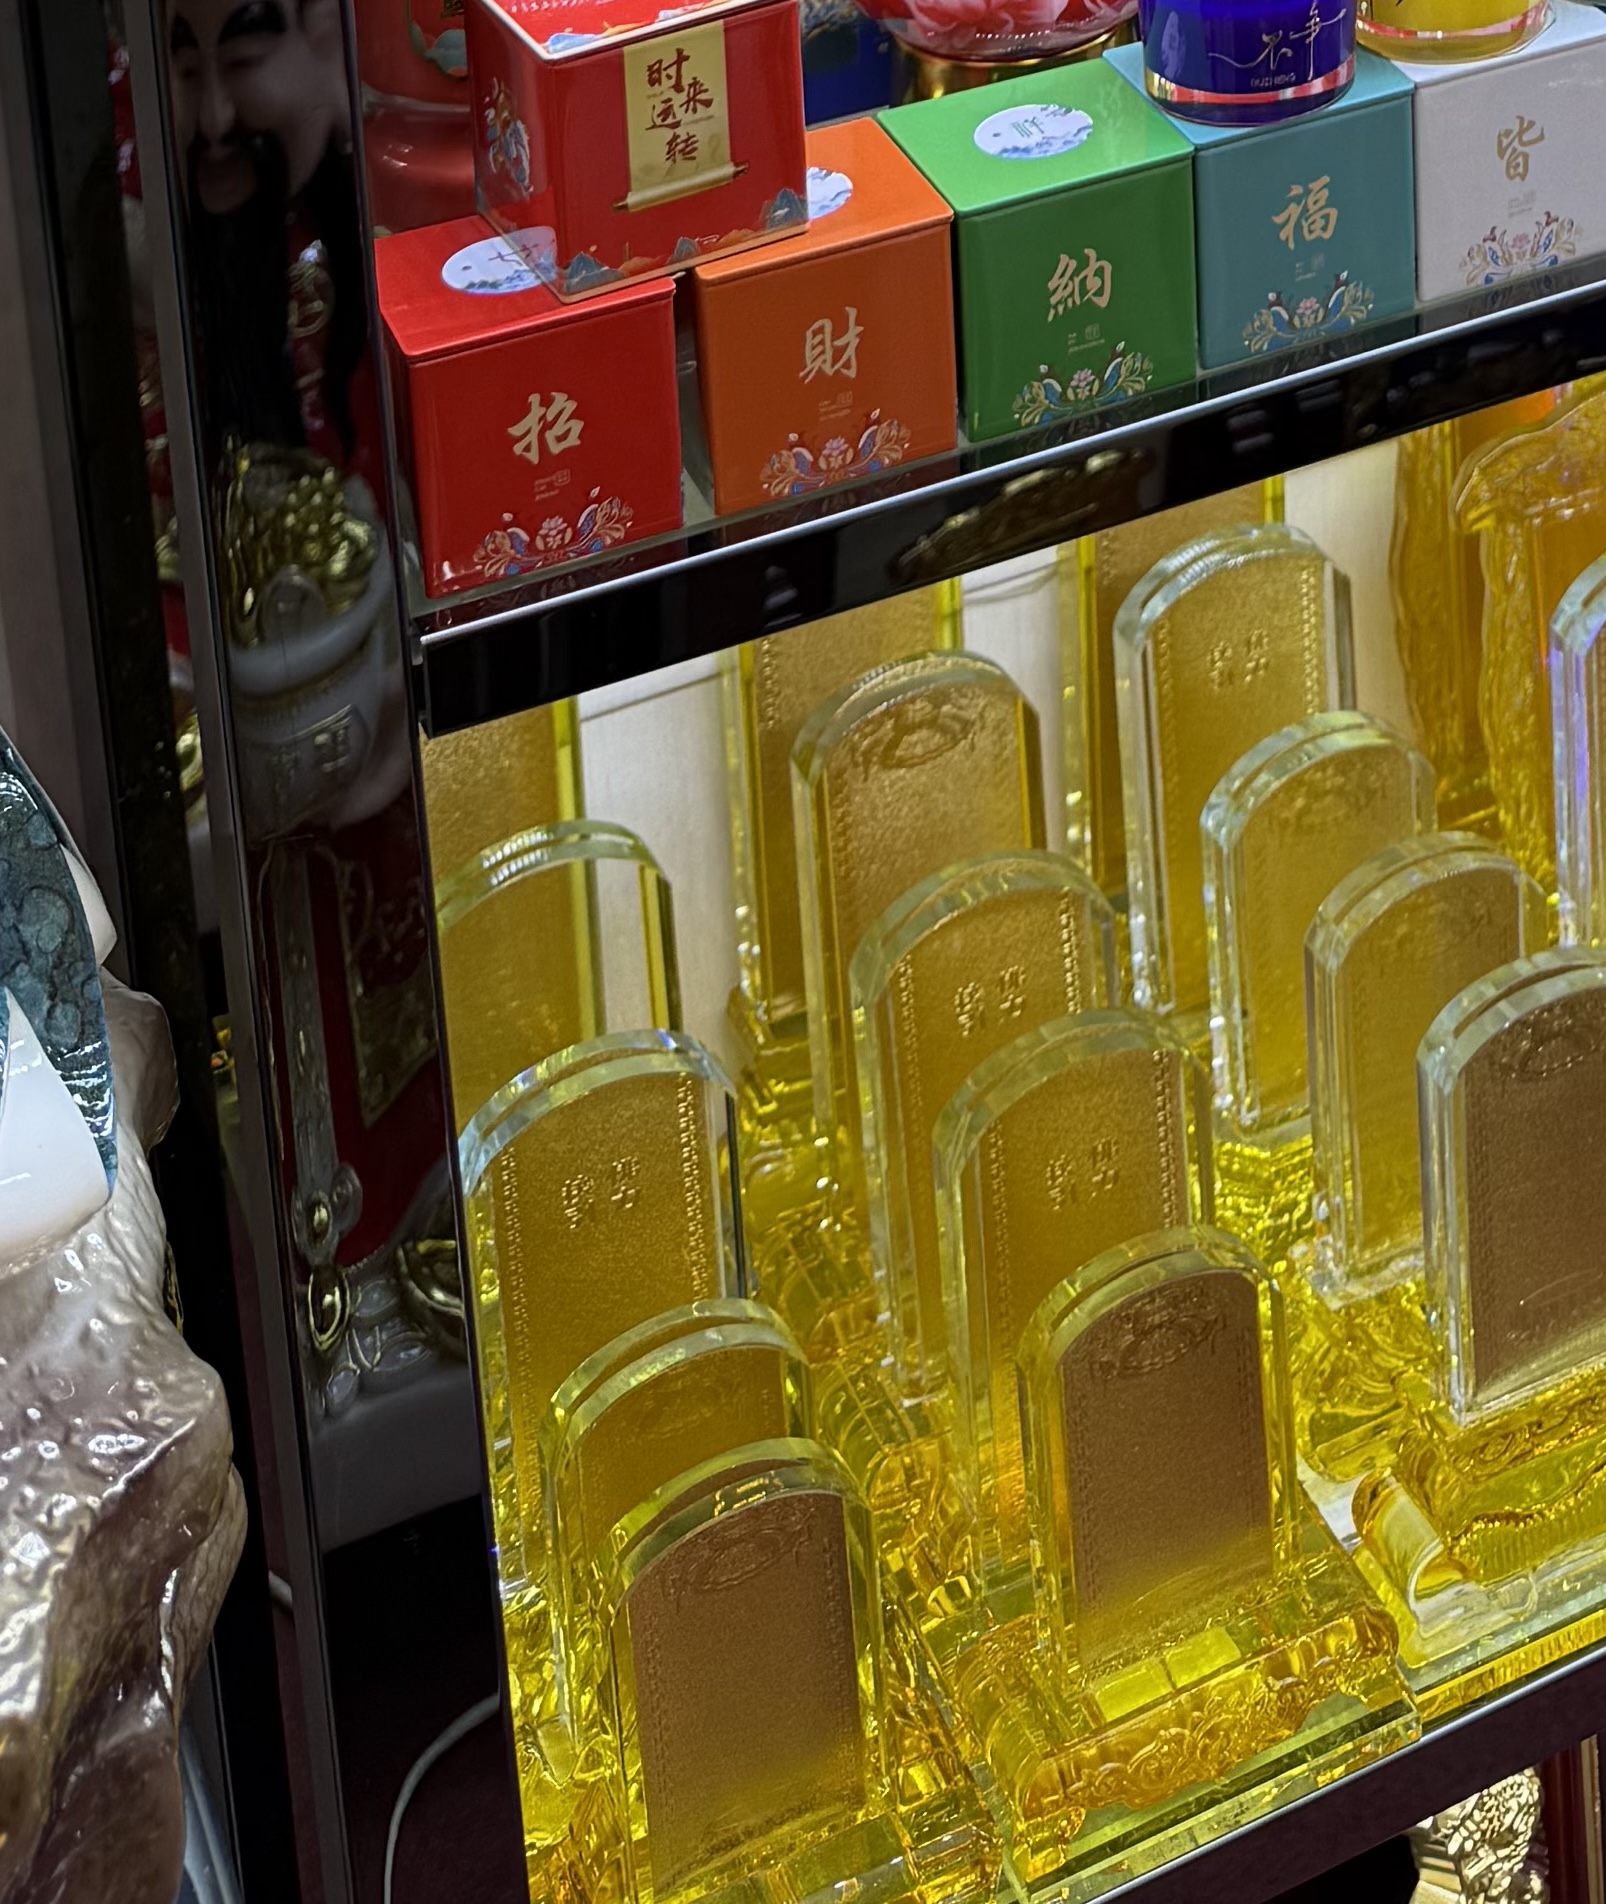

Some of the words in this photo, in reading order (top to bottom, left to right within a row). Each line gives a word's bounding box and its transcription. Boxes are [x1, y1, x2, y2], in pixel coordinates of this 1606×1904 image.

[1495, 114, 1546, 183] 皆
[1270, 174, 1339, 250] 福
[1046, 247, 1114, 323] 納
[799, 306, 865, 385] 財
[507, 391, 585, 465] 招
